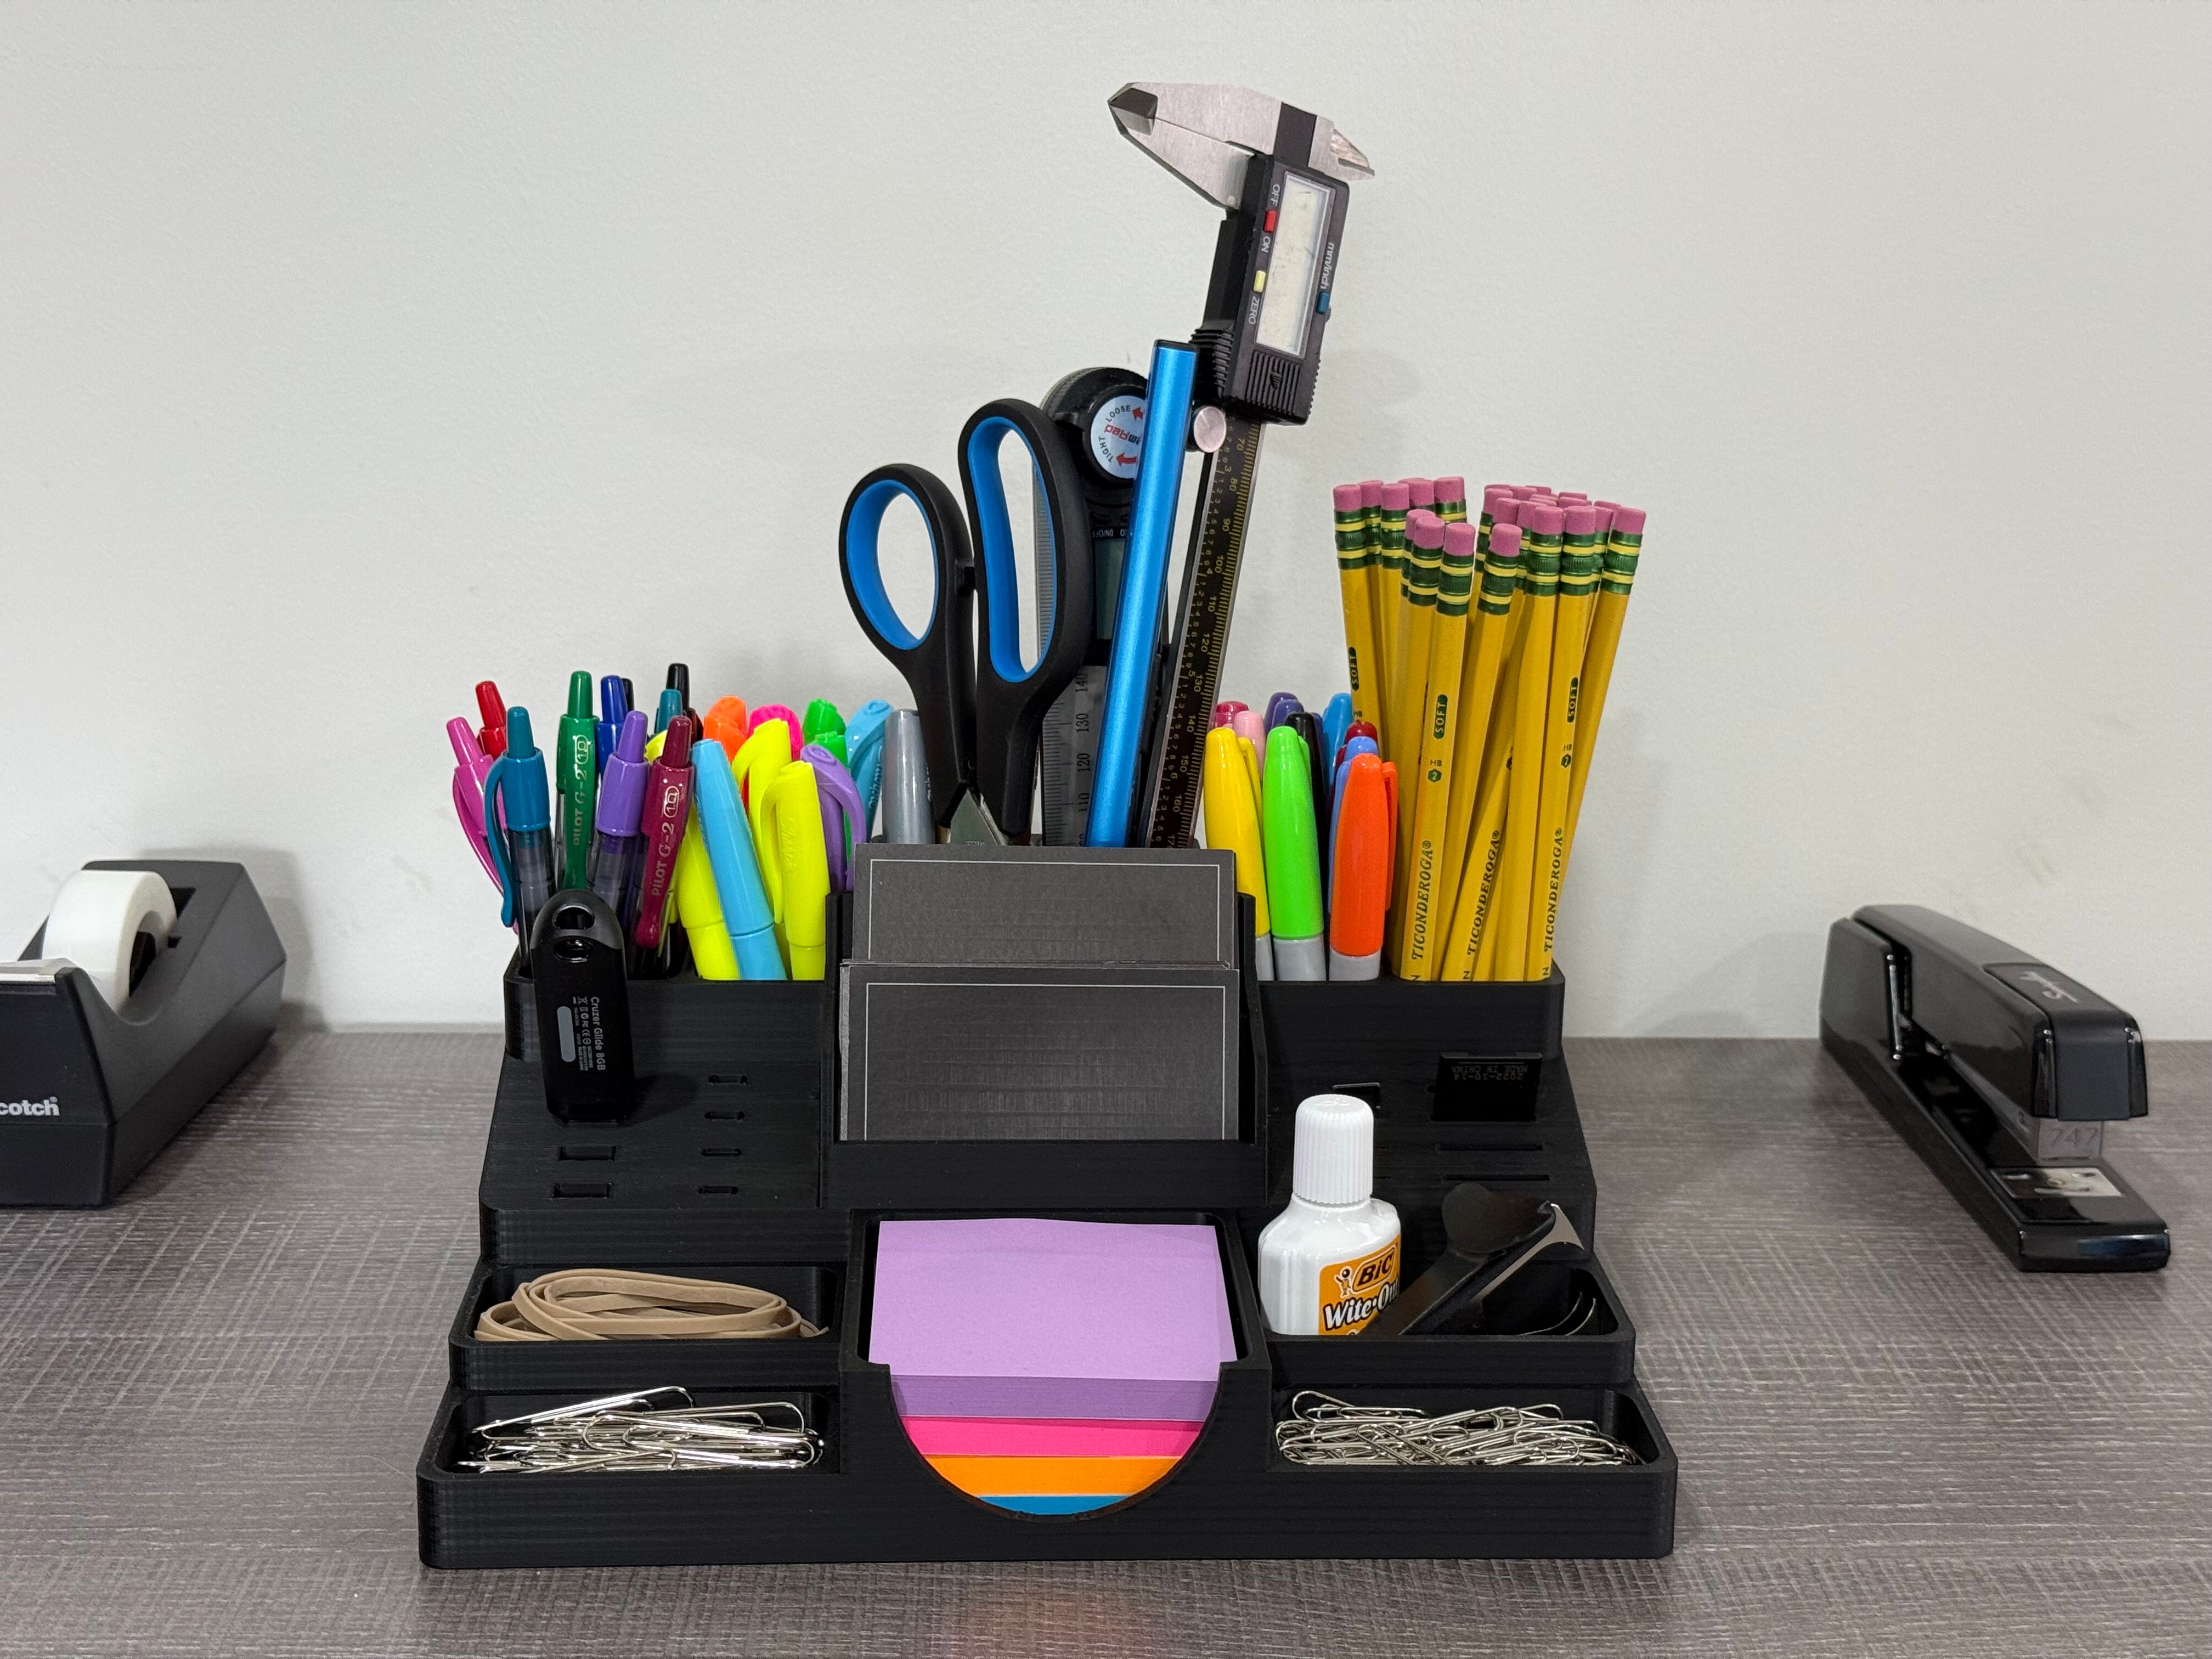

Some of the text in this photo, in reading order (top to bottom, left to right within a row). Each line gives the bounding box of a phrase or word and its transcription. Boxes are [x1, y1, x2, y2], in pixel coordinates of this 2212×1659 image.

[1271, 184, 1280, 206] OFF
[1261, 236, 1271, 253] ON
[1321, 242, 1334, 289] mm/inch
[1248, 296, 1260, 325] ZERO
[1105, 405, 1131, 422] LOOSE
[1098, 436, 1114, 463] TIGHT
[1237, 438, 1245, 451] 70
[1229, 477, 1238, 492] 80
[1222, 518, 1231, 532] 90
[1215, 555, 1224, 573] 100
[1207, 596, 1216, 612] 110
[1200, 633, 1210, 652] 120
[1350, 654, 1358, 685] SOFT
[1075, 673, 1088, 693] 140
[1194, 674, 1203, 692] 130
[1568, 685, 1577, 719] SOFT
[1076, 713, 1089, 733] 130
[1187, 714, 1196, 732] 140
[1435, 703, 1446, 735] SOFT
[1563, 743, 1572, 752] HB
[1077, 753, 1090, 772] 120
[1180, 754, 1189, 772] 150
[1432, 771, 1438, 781] 2
[574, 768, 587, 804] G-2
[1078, 793, 1090, 812] 110
[1173, 794, 1182, 812] 160
[573, 808, 584, 846] PILOT
[658, 822, 674, 857] G-2
[651, 860, 667, 896] PILOT
[591, 996, 606, 1070] Cruzer Glide 8GB
[1452, 1065, 1481, 1073] CHINA
[0, 1096, 60, 1116] cotch
[2053, 1127, 2098, 1148] 747
